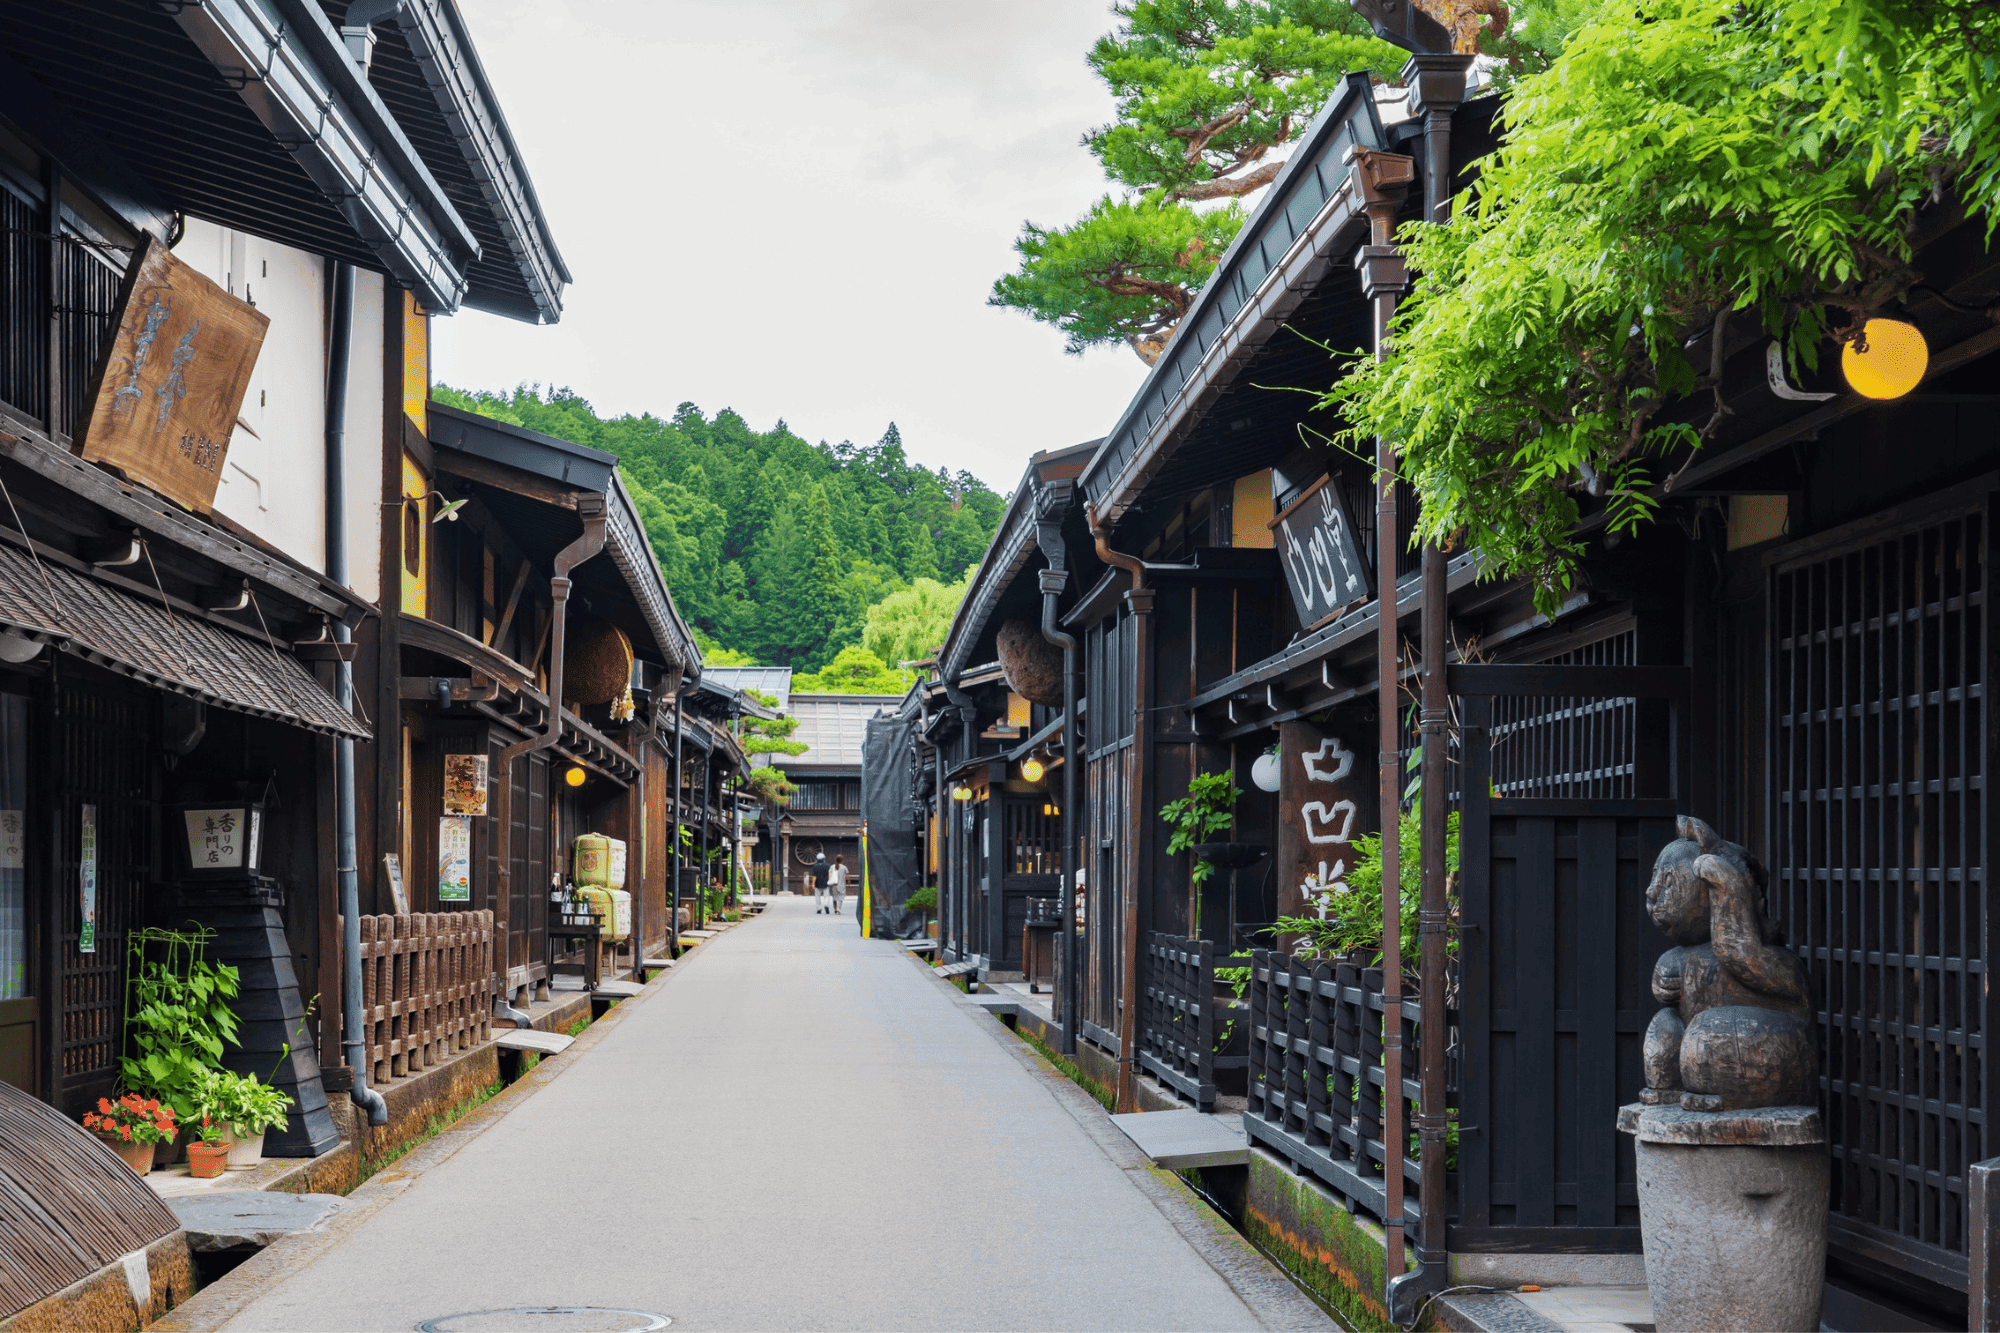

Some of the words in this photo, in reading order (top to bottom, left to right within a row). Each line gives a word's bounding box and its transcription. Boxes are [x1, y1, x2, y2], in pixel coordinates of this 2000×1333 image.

[202, 816, 219, 863] 専門店
[218, 812, 236, 855] 香りの
